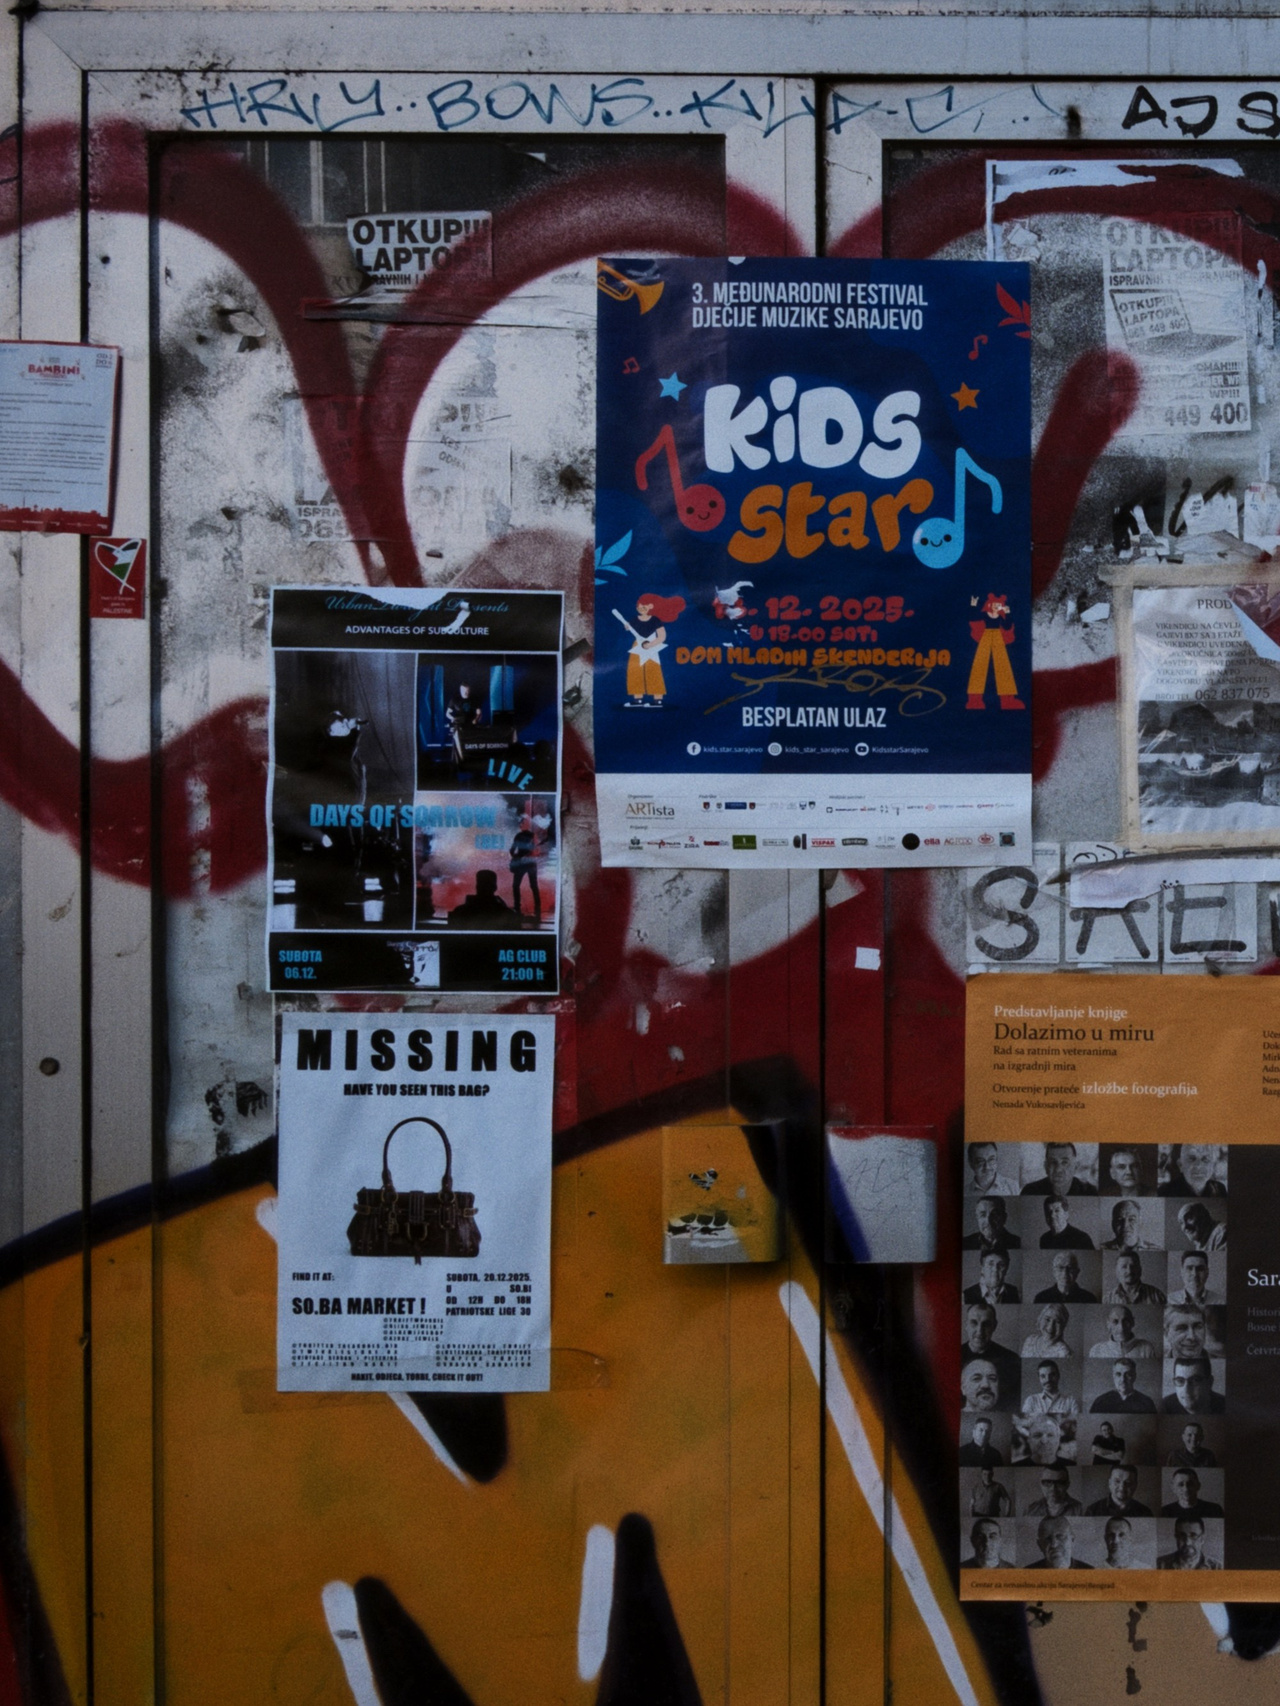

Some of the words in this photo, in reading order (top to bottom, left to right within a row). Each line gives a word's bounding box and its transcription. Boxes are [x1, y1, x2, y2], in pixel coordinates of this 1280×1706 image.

[691, 283, 708, 304] 3.
[712, 282, 843, 305] MEĐUNARODNI
[846, 283, 929, 306] FESTIVAL
[692, 302, 758, 329] DJEČIJE
[762, 306, 829, 329] MUZIKE
[834, 306, 923, 331] SARAJEVO
[28, 364, 80, 375] BAMBINI
[1210, 401, 1248, 425] 400
[1197, 599, 1233, 610] PROD
[345, 625, 411, 635] ADVANTAGES
[412, 625, 427, 635] OF
[675, 645, 722, 665] DOM
[1195, 689, 1217, 700] 062
[1221, 687, 1243, 700] 837
[1247, 686, 1270, 699] 075
[741, 706, 839, 728] BESPLATAN
[843, 706, 887, 728] ULAZ
[487, 757, 534, 790] LIVE
[309, 803, 365, 828] DAYS
[369, 803, 395, 828] OF
[400, 804, 498, 828] SORROW
[625, 802, 675, 816] ARTista
[278, 949, 323, 963] SUBOTA
[498, 949, 514, 963] AG
[516, 949, 548, 963] CLUB
[284, 966, 317, 980] 06.12.
[501, 967, 534, 981] 21:00
[535, 967, 545, 981] h
[993, 1005, 1085, 1020] Predstavljanje
[1087, 1005, 1128, 1021] knjige
[994, 1022, 1086, 1041] Dolazimo
[1091, 1027, 1103, 1041] u
[1108, 1024, 1155, 1042] miru
[296, 1028, 537, 1073] MISSING
[993, 1045, 1013, 1056] Rad
[1015, 1047, 1025, 1056] sa
[1027, 1046, 1061, 1056] ratnim
[1062, 1046, 1118, 1057] veteranima
[993, 1062, 1005, 1071] na
[1007, 1060, 1051, 1072] izgradnji
[1053, 1061, 1076, 1071] mira
[343, 1083, 373, 1096] HAVE
[376, 1083, 397, 1096] YOU
[399, 1084, 427, 1096] SEEN
[430, 1084, 456, 1096] THIS
[458, 1084, 490, 1097] BAG?
[992, 1083, 1042, 1095] Otvorenje
[1043, 1084, 1080, 1096] prateće
[1082, 1081, 1128, 1095] izložbe
[1131, 1082, 1198, 1098] fotografija
[992, 1100, 1024, 1109] Nenada
[1025, 1100, 1085, 1111] Vukosavljevića
[292, 1272, 310, 1281] FIND
[312, 1272, 320, 1281] IT
[321, 1272, 335, 1281] AT:
[446, 1273, 481, 1282] SUBOTA,
[484, 1273, 532, 1282] 20.12.2025.
[292, 1297, 342, 1315] SO.BA
[347, 1297, 416, 1316] MARKET
[446, 1296, 457, 1304] OD
[468, 1296, 484, 1305] 12H
[494, 1296, 506, 1304] DO
[517, 1296, 532, 1305] 18H
[446, 1307, 495, 1316] PATRIOTSKE
[499, 1307, 516, 1316] LIGE
[520, 1307, 531, 1316] 30
[1246, 1322, 1277, 1333] Bosne
[432, 1373, 456, 1381] CHECK
[457, 1373, 464, 1381] IT
